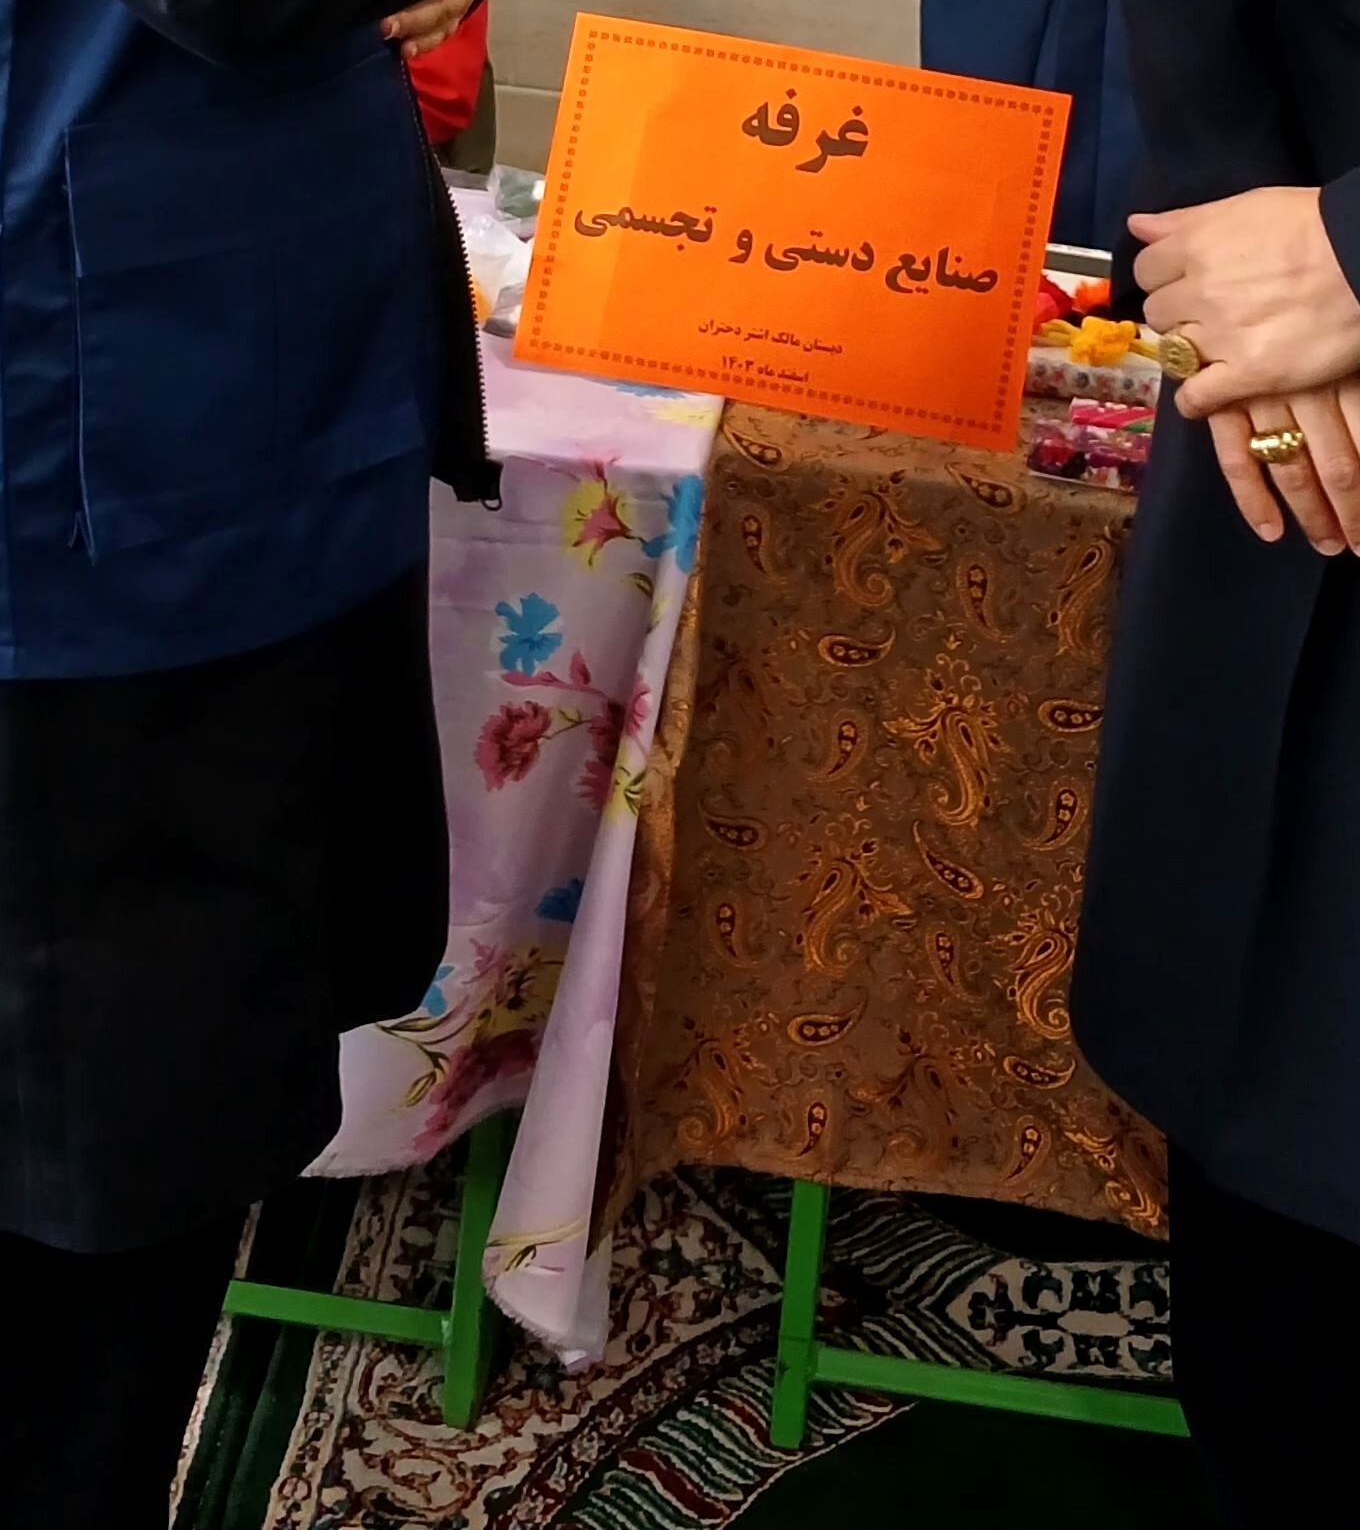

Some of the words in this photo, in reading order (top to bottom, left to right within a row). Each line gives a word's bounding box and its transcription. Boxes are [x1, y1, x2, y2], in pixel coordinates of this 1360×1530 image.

[741, 88, 870, 173] غرفه
[574, 205, 717, 252] تجسمی
[728, 228, 754, 263] و
[764, 228, 874, 271] دستی
[885, 245, 999, 295] صنایع
[698, 319, 741, 336] دختران
[771, 331, 800, 347] مالک
[803, 338, 843, 354] دبستان
[721, 355, 754, 371] ۱۴۰۳
[757, 364, 775, 377] ماه
[777, 368, 809, 382] اسفند
